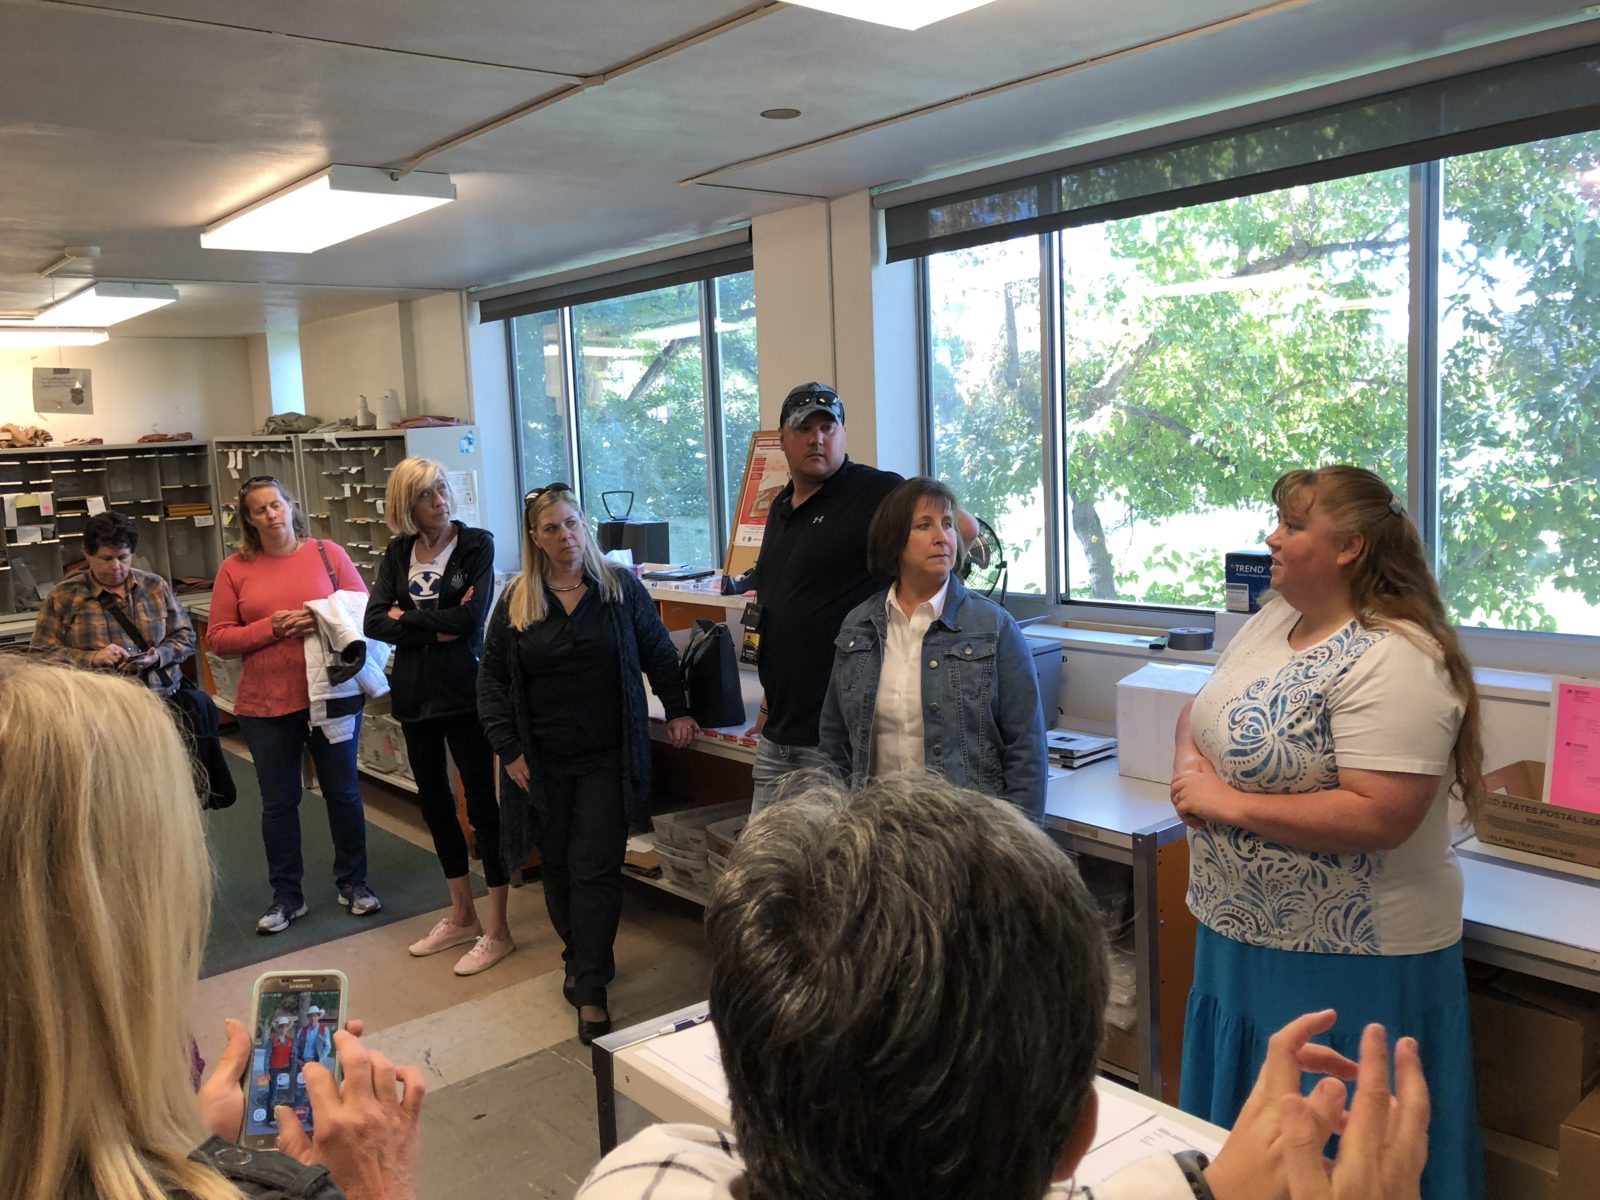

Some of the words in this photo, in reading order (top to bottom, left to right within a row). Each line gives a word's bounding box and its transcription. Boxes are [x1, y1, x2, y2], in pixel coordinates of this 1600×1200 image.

[1235, 564, 1264, 573] TREND
[411, 573, 441, 595] Y
[1502, 801, 1537, 814] STATES
[1540, 809, 1579, 823] POSTAL
